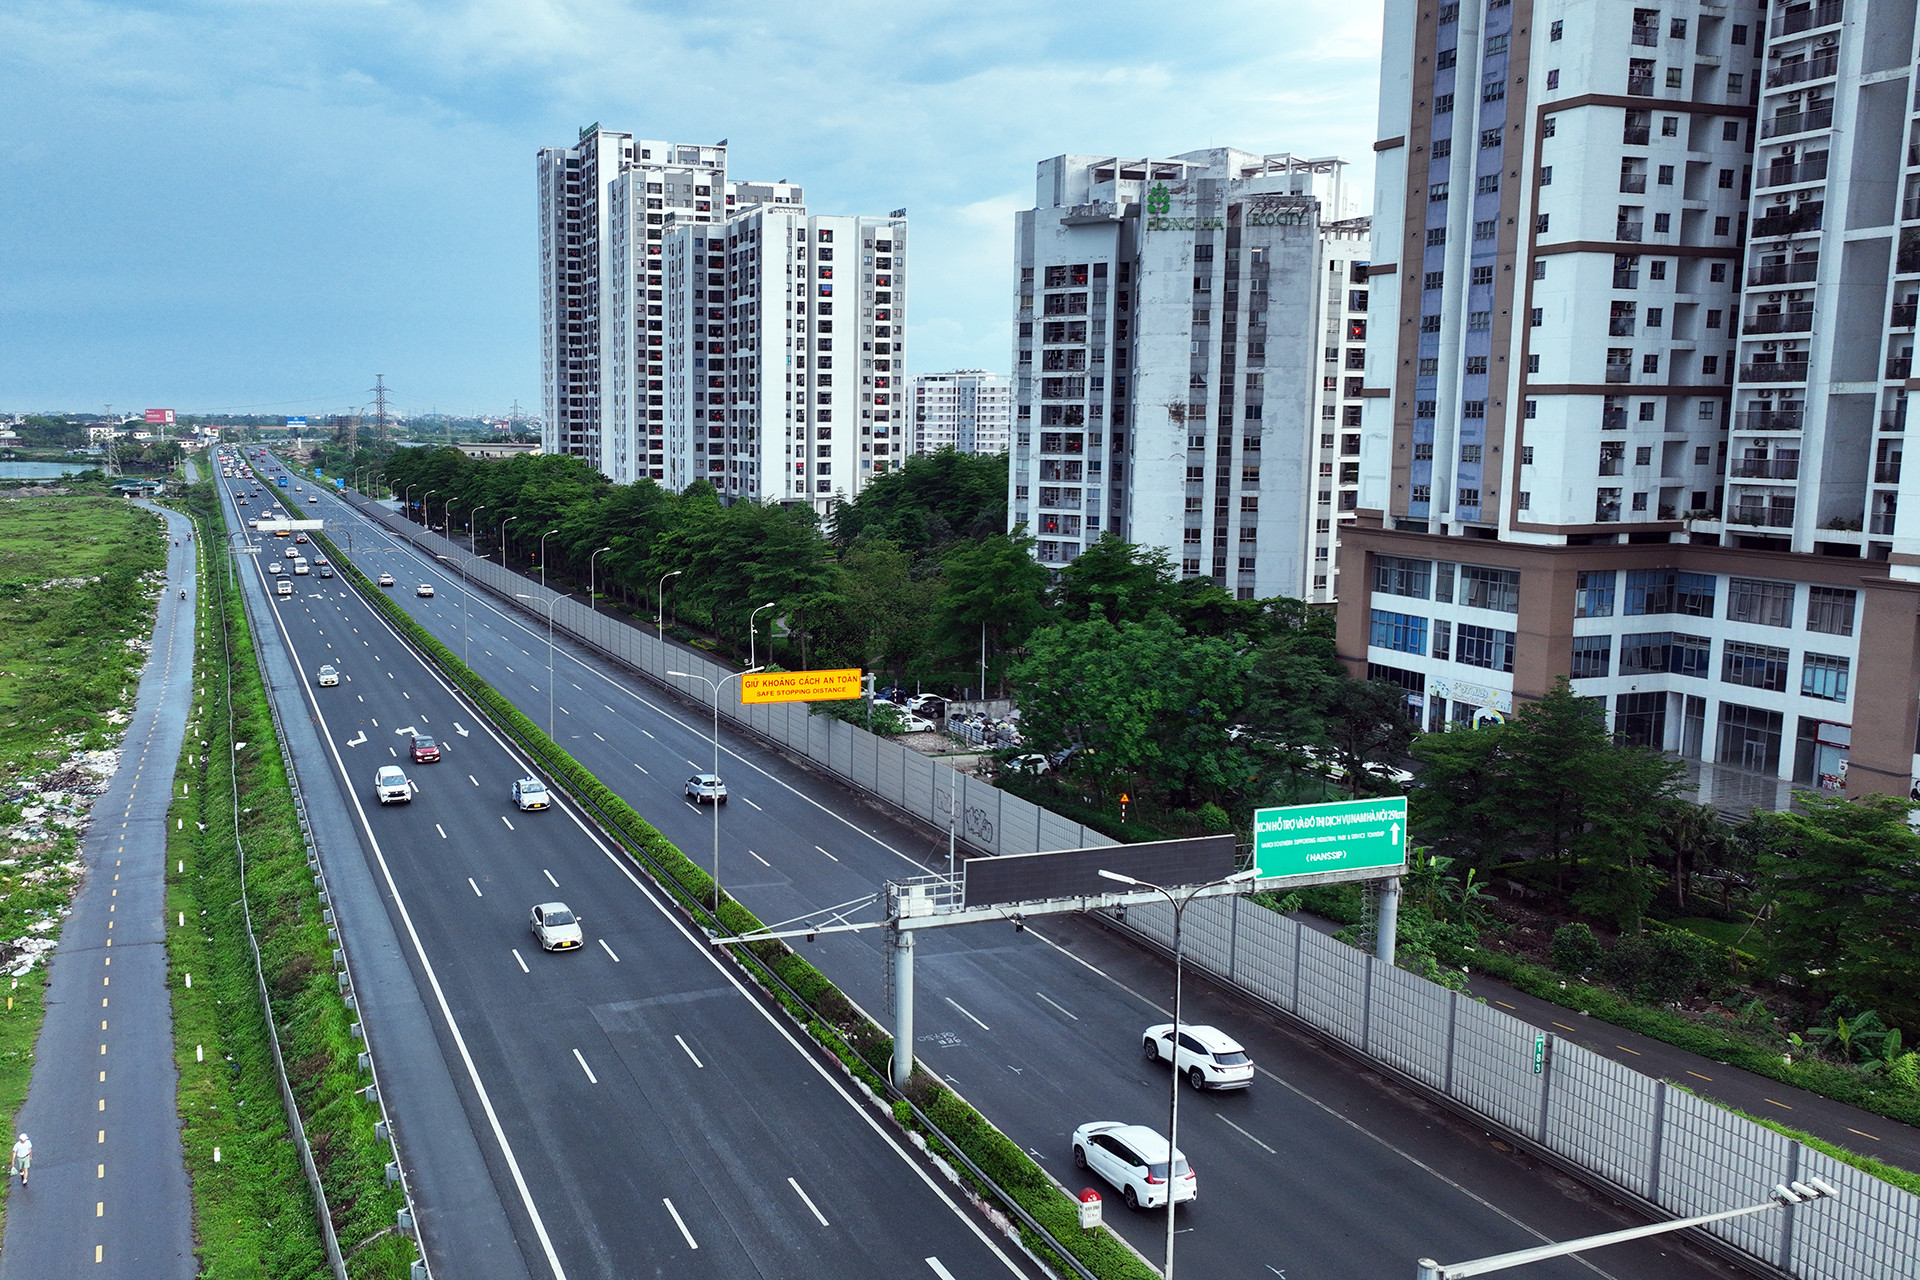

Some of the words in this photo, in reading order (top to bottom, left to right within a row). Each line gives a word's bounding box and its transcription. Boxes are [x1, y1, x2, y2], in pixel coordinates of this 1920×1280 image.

[798, 675, 820, 686] CÁCH
[823, 676, 834, 685] AN
[837, 673, 858, 684] TOÀN
[776, 688, 811, 696] STOPPING
[812, 686, 847, 694] DISTANCE
[1306, 850, 1347, 862] (HANSSIP)
